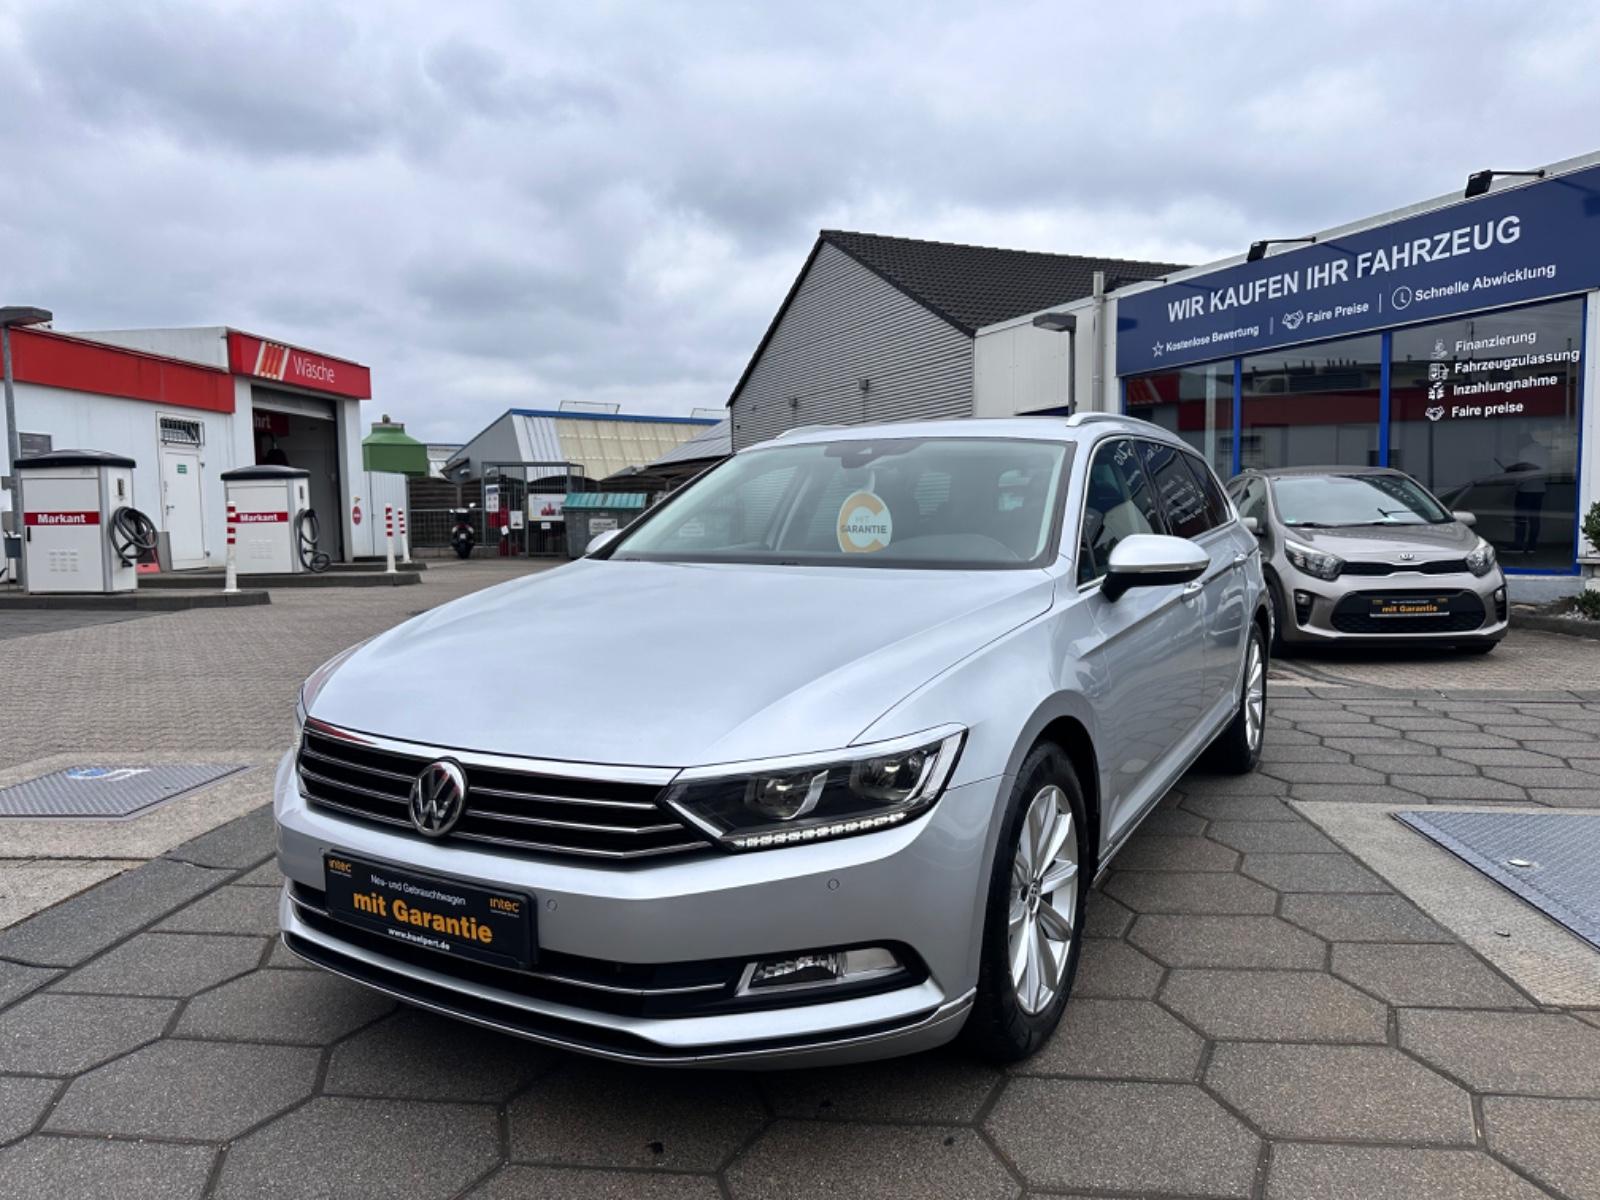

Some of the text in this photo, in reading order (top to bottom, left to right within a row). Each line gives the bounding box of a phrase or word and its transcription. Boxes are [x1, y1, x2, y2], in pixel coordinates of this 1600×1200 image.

[1167, 215, 1521, 323] WIR KAUFEN IHR FAHRZEUG
[1415, 264, 1557, 302] Schnelle Abwicklung
[1306, 301, 1369, 324] Faire Preise
[1166, 325, 1260, 352] Kostenlose Bewertung
[1455, 332, 1537, 352] Finanzierung
[292, 355, 335, 384] Wäsche
[1454, 350, 1581, 374] Fahrzeugzulassung
[1453, 375, 1558, 396] Inzahlungnahme
[1451, 401, 1524, 418] Faire preise
[37, 513, 87, 524] Markant
[240, 513, 279, 522] Markant
[1382, 604, 1438, 613] mit Garantie
[353, 892, 493, 944] mit Garantie
